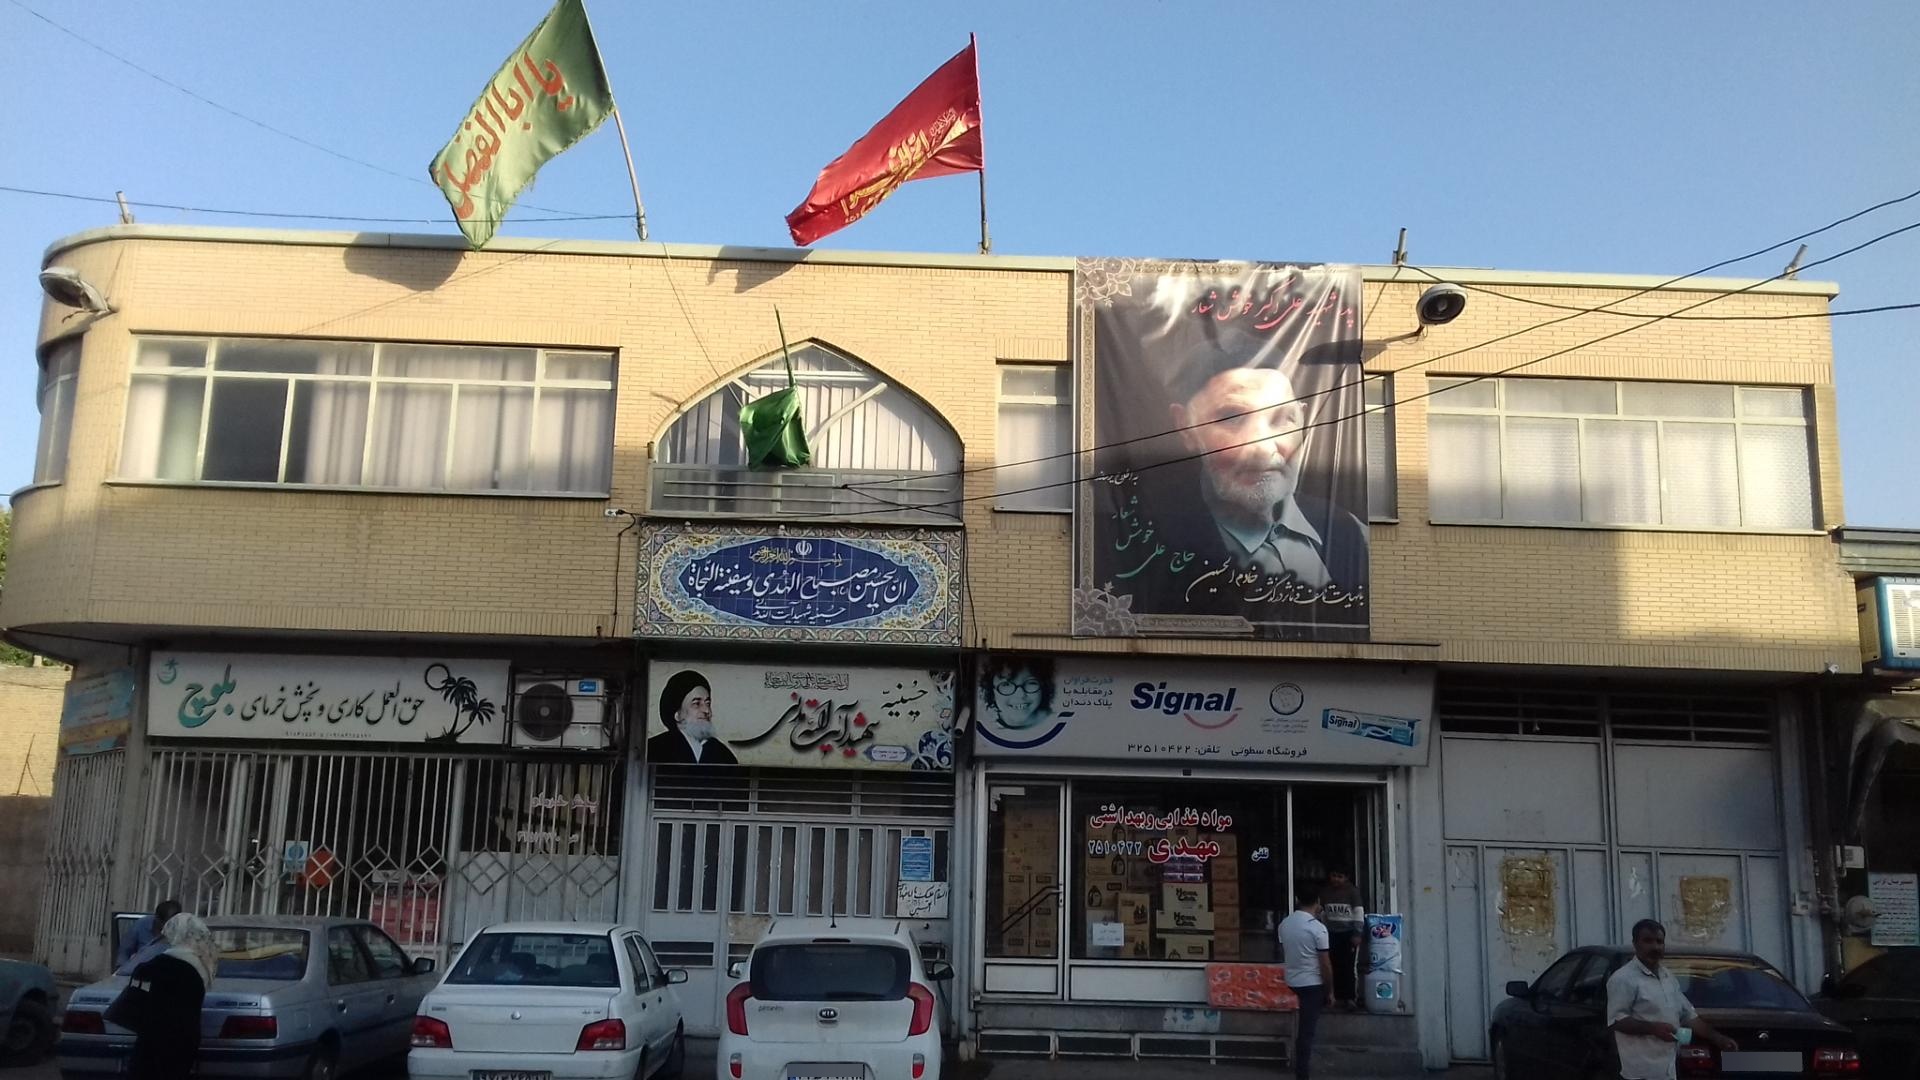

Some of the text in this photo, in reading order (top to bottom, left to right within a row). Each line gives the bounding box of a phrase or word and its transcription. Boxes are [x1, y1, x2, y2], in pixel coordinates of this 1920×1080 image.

[526, 52, 575, 112] یا
[1254, 297, 1303, 330] علی
[1115, 543, 1167, 579] علی
[1169, 550, 1197, 573] حاج
[743, 579, 753, 592] و
[800, 566, 879, 600] مصباح
[1185, 556, 1259, 602] خادم الحسین
[791, 603, 812, 624] شهید
[177, 663, 237, 729] بلوچ
[240, 687, 285, 722] خرمای
[282, 681, 321, 722] پخش
[327, 689, 375, 724] کاری
[1062, 698, 1113, 709] پلاک دندان
[1063, 687, 1113, 697] در مقابله با
[1130, 682, 1238, 716] Signal
[317, 701, 324, 716] و
[398, 696, 425, 725] حق
[1328, 714, 1358, 729] Signal
[838, 712, 880, 757] شهید
[1266, 745, 1307, 758] فروشگاه
[1090, 803, 1232, 831] مواد غذایی و بهداشتی
[1147, 836, 1221, 864] مهدی
